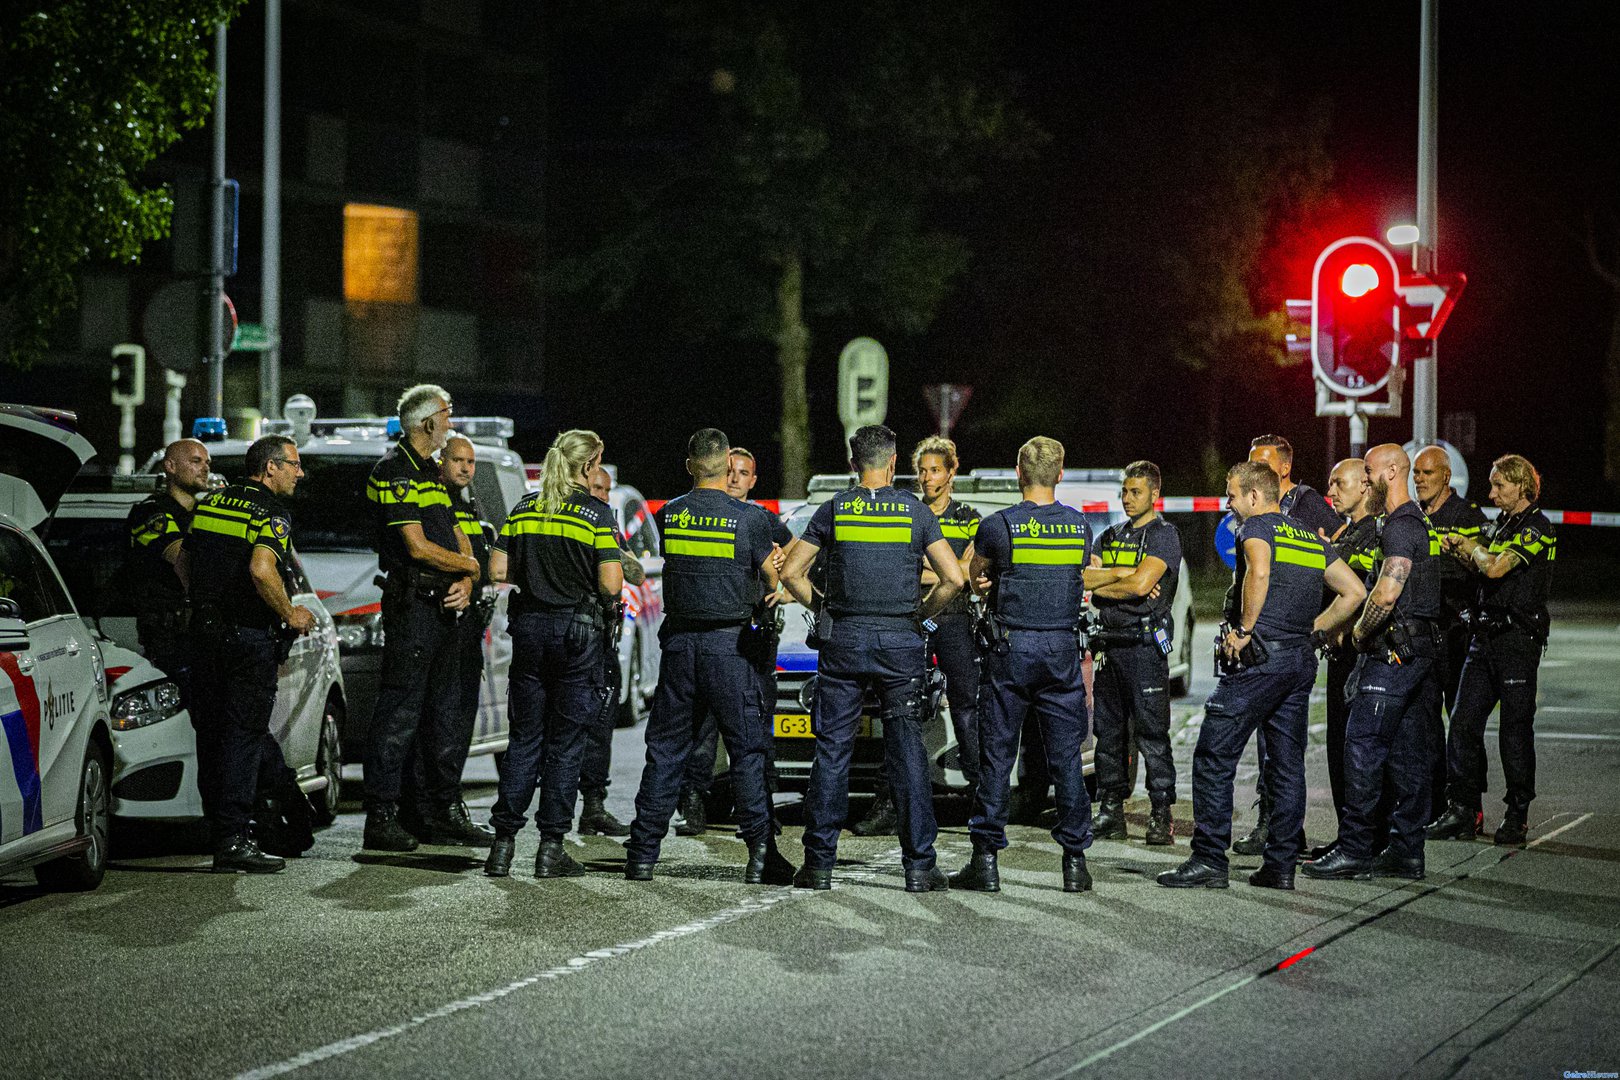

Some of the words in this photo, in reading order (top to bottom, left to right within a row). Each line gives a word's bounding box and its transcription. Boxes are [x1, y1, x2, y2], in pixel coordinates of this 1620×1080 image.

[528, 500, 582, 513] POTIE
[844, 496, 905, 514] POLITIE
[672, 508, 728, 528] POLITIE
[1020, 517, 1077, 537] POLITIE
[1277, 522, 1317, 540] POLITIE
[43, 682, 75, 730] POLITIE
